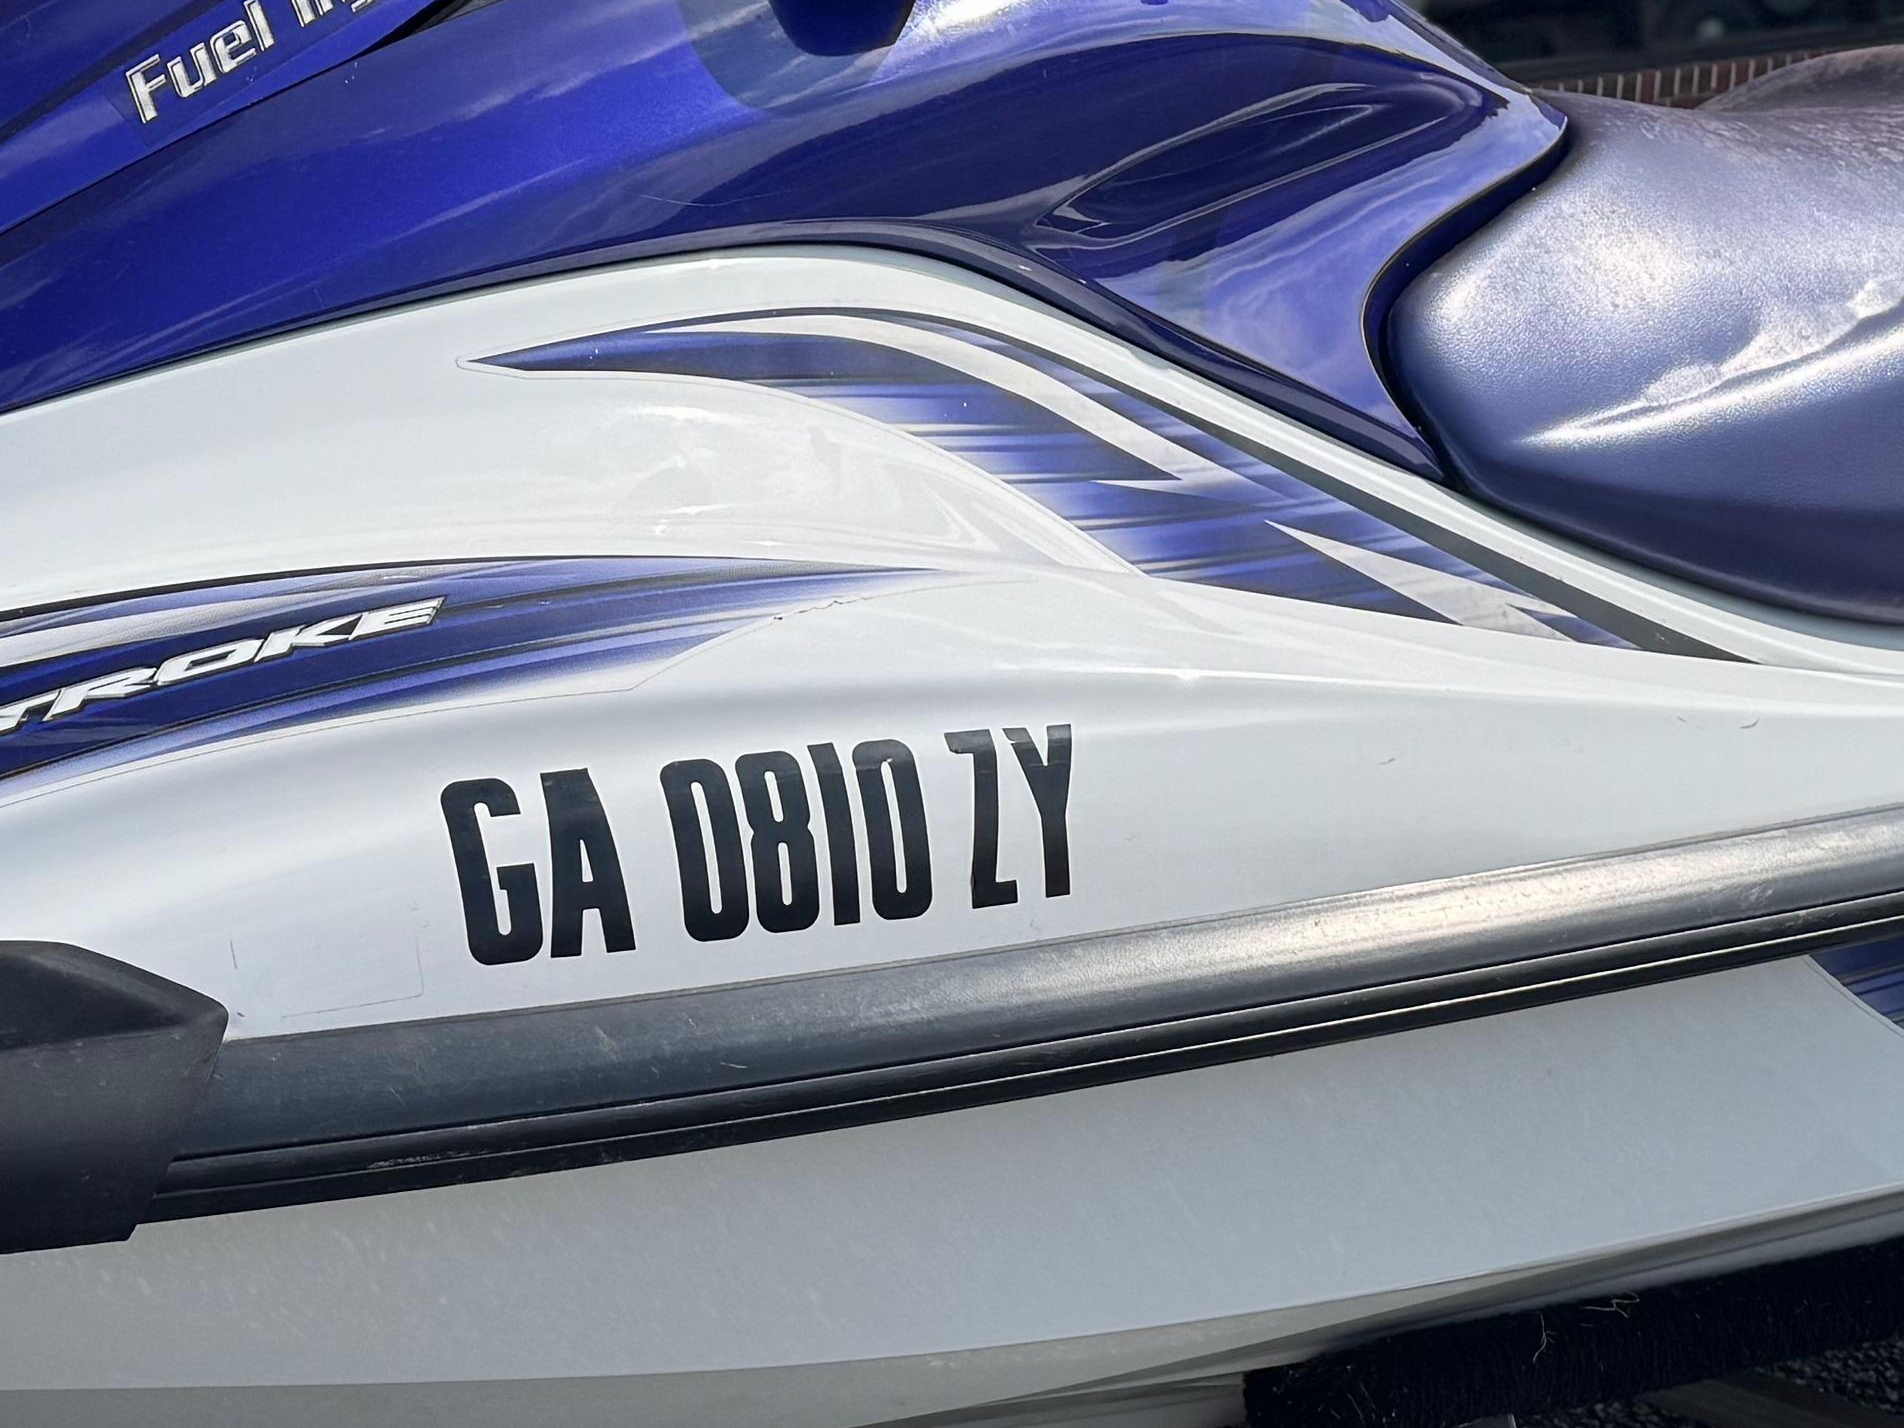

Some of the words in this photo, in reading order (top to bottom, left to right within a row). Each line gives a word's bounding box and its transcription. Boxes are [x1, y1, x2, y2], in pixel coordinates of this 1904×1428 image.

[440, 768, 636, 966] GA
[659, 739, 933, 942] 0810
[944, 724, 1072, 910] ZY
